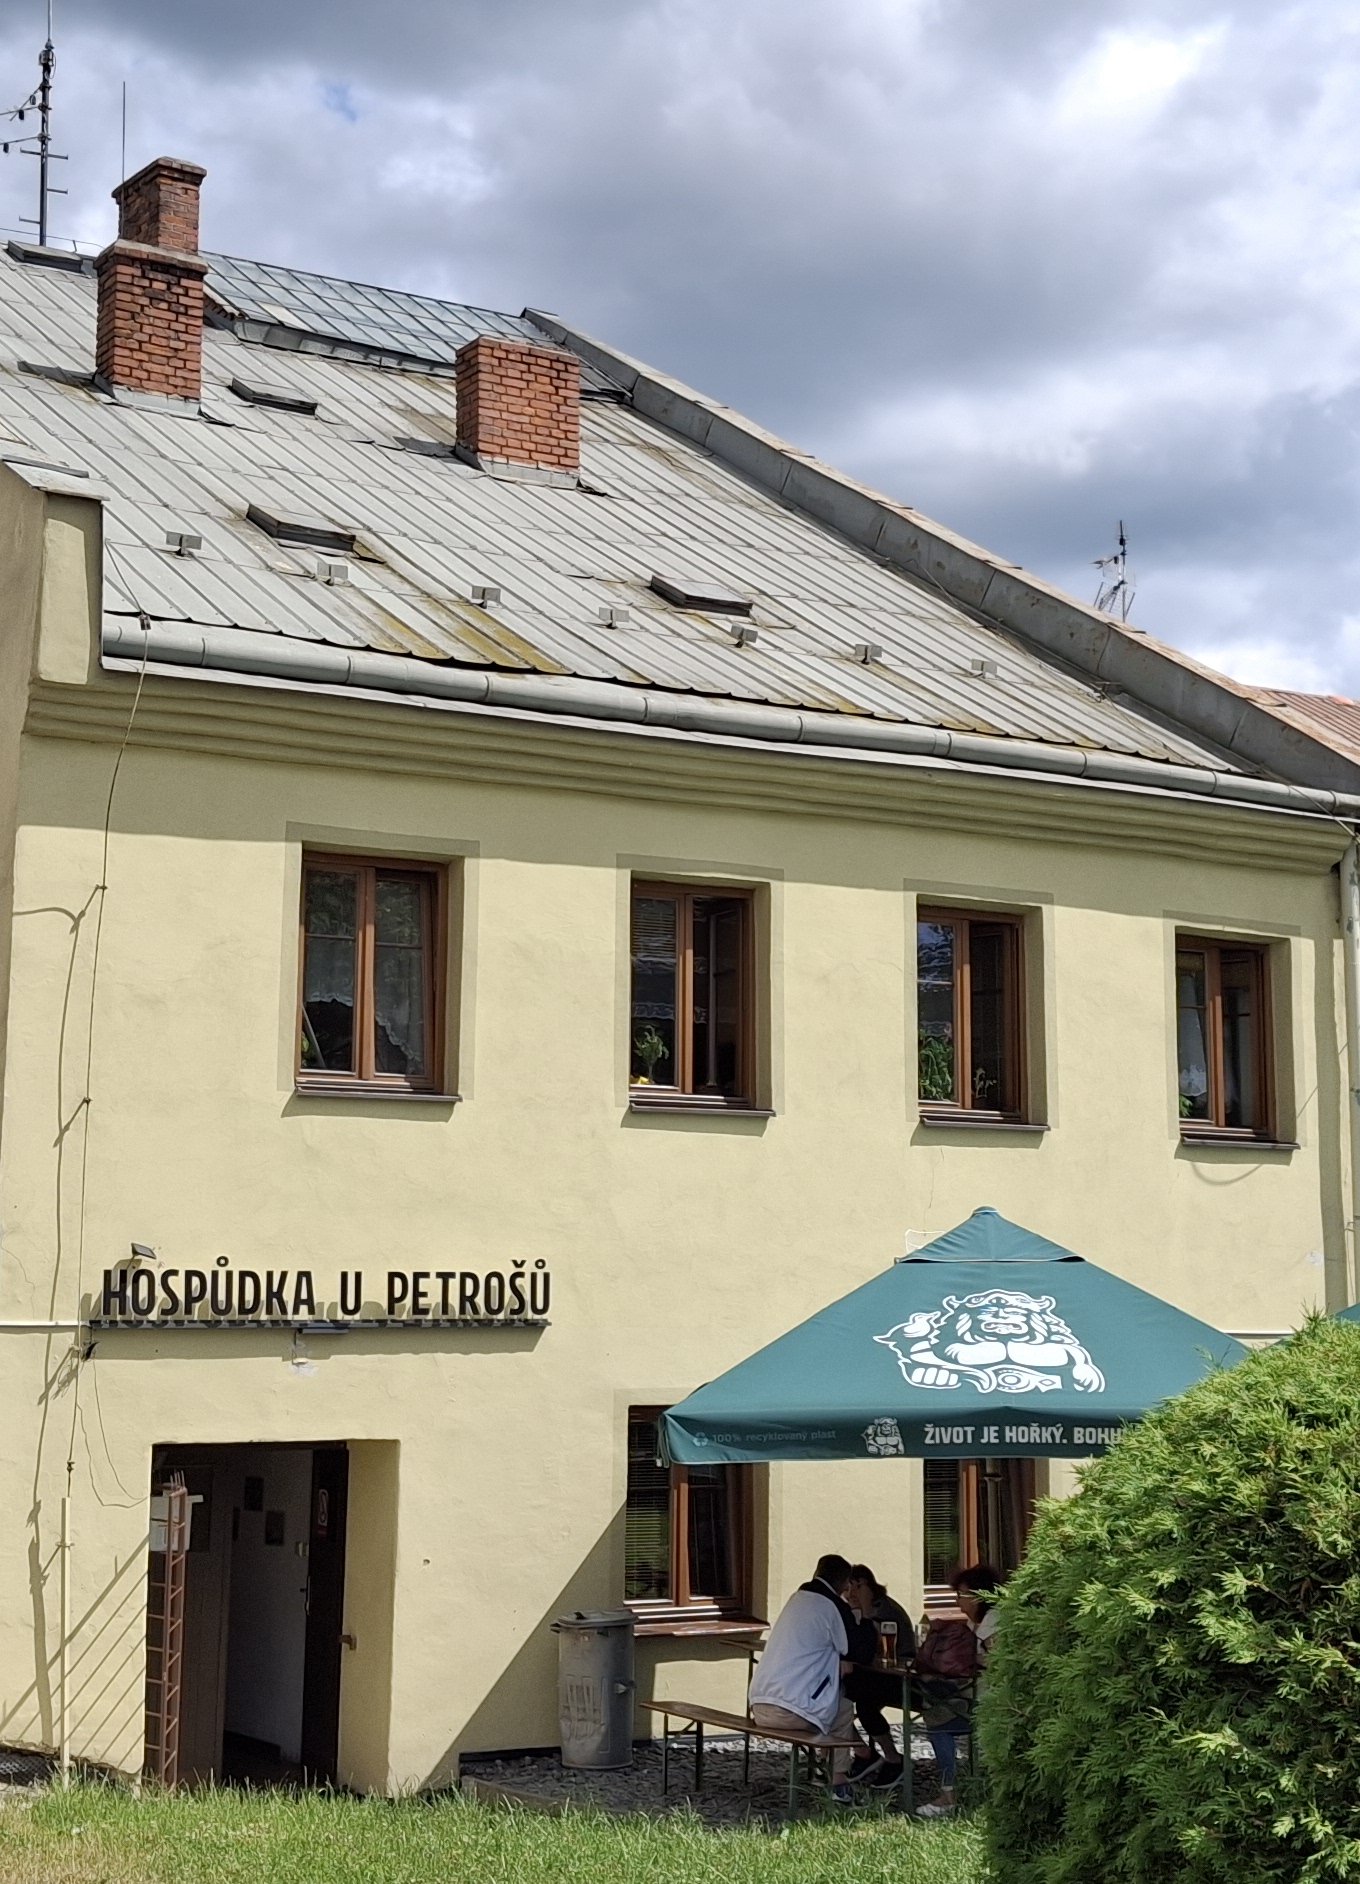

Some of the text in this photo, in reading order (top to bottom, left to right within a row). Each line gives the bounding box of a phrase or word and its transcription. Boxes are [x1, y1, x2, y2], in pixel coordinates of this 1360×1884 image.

[102, 1256, 551, 1317] HOSPŮDKA U PETROŠŮ
[712, 1430, 836, 1444] 100% recyklovaný plast
[924, 1422, 1125, 1445] ŽIVOT JE HOŘKÝ. BOHU
